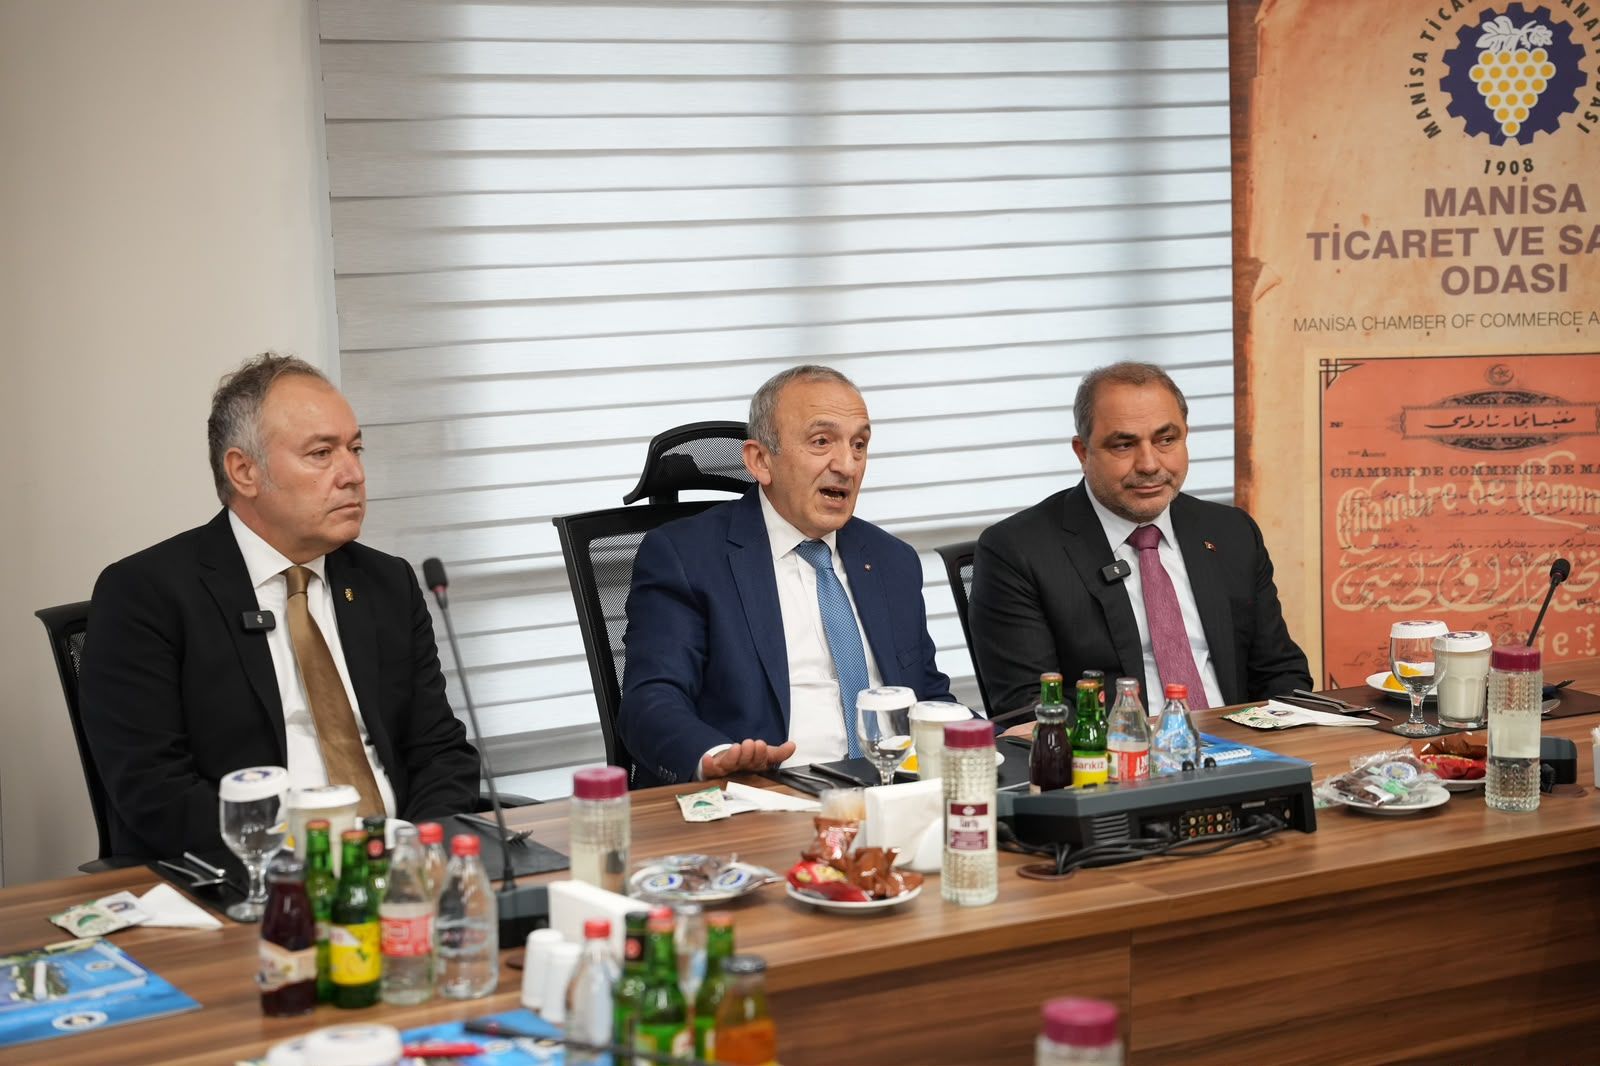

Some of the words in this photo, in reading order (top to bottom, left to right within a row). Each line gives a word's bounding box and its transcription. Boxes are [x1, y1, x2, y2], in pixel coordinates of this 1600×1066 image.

[1420, 0, 1472, 42] TİCA
[1404, 52, 1442, 139] MANİSA
[1483, 158, 1534, 175] 1908
[1425, 176, 1587, 218] MANİSA
[1306, 223, 1479, 262] TİCARET
[1494, 226, 1545, 257] VE
[1441, 263, 1568, 296] ODASI
[1293, 314, 1356, 332] MANİSA
[1361, 315, 1446, 331] CHAMBER
[1451, 313, 1474, 329] OF
[1480, 310, 1583, 328] COMMERCE
[1330, 466, 1417, 478] CHAMBRE
[1421, 466, 1444, 477] DE
[1449, 464, 1546, 476] COMMERCE
[1550, 464, 1574, 475] DE
[1336, 469, 1457, 554] Chambre
[1468, 461, 1506, 507] de
